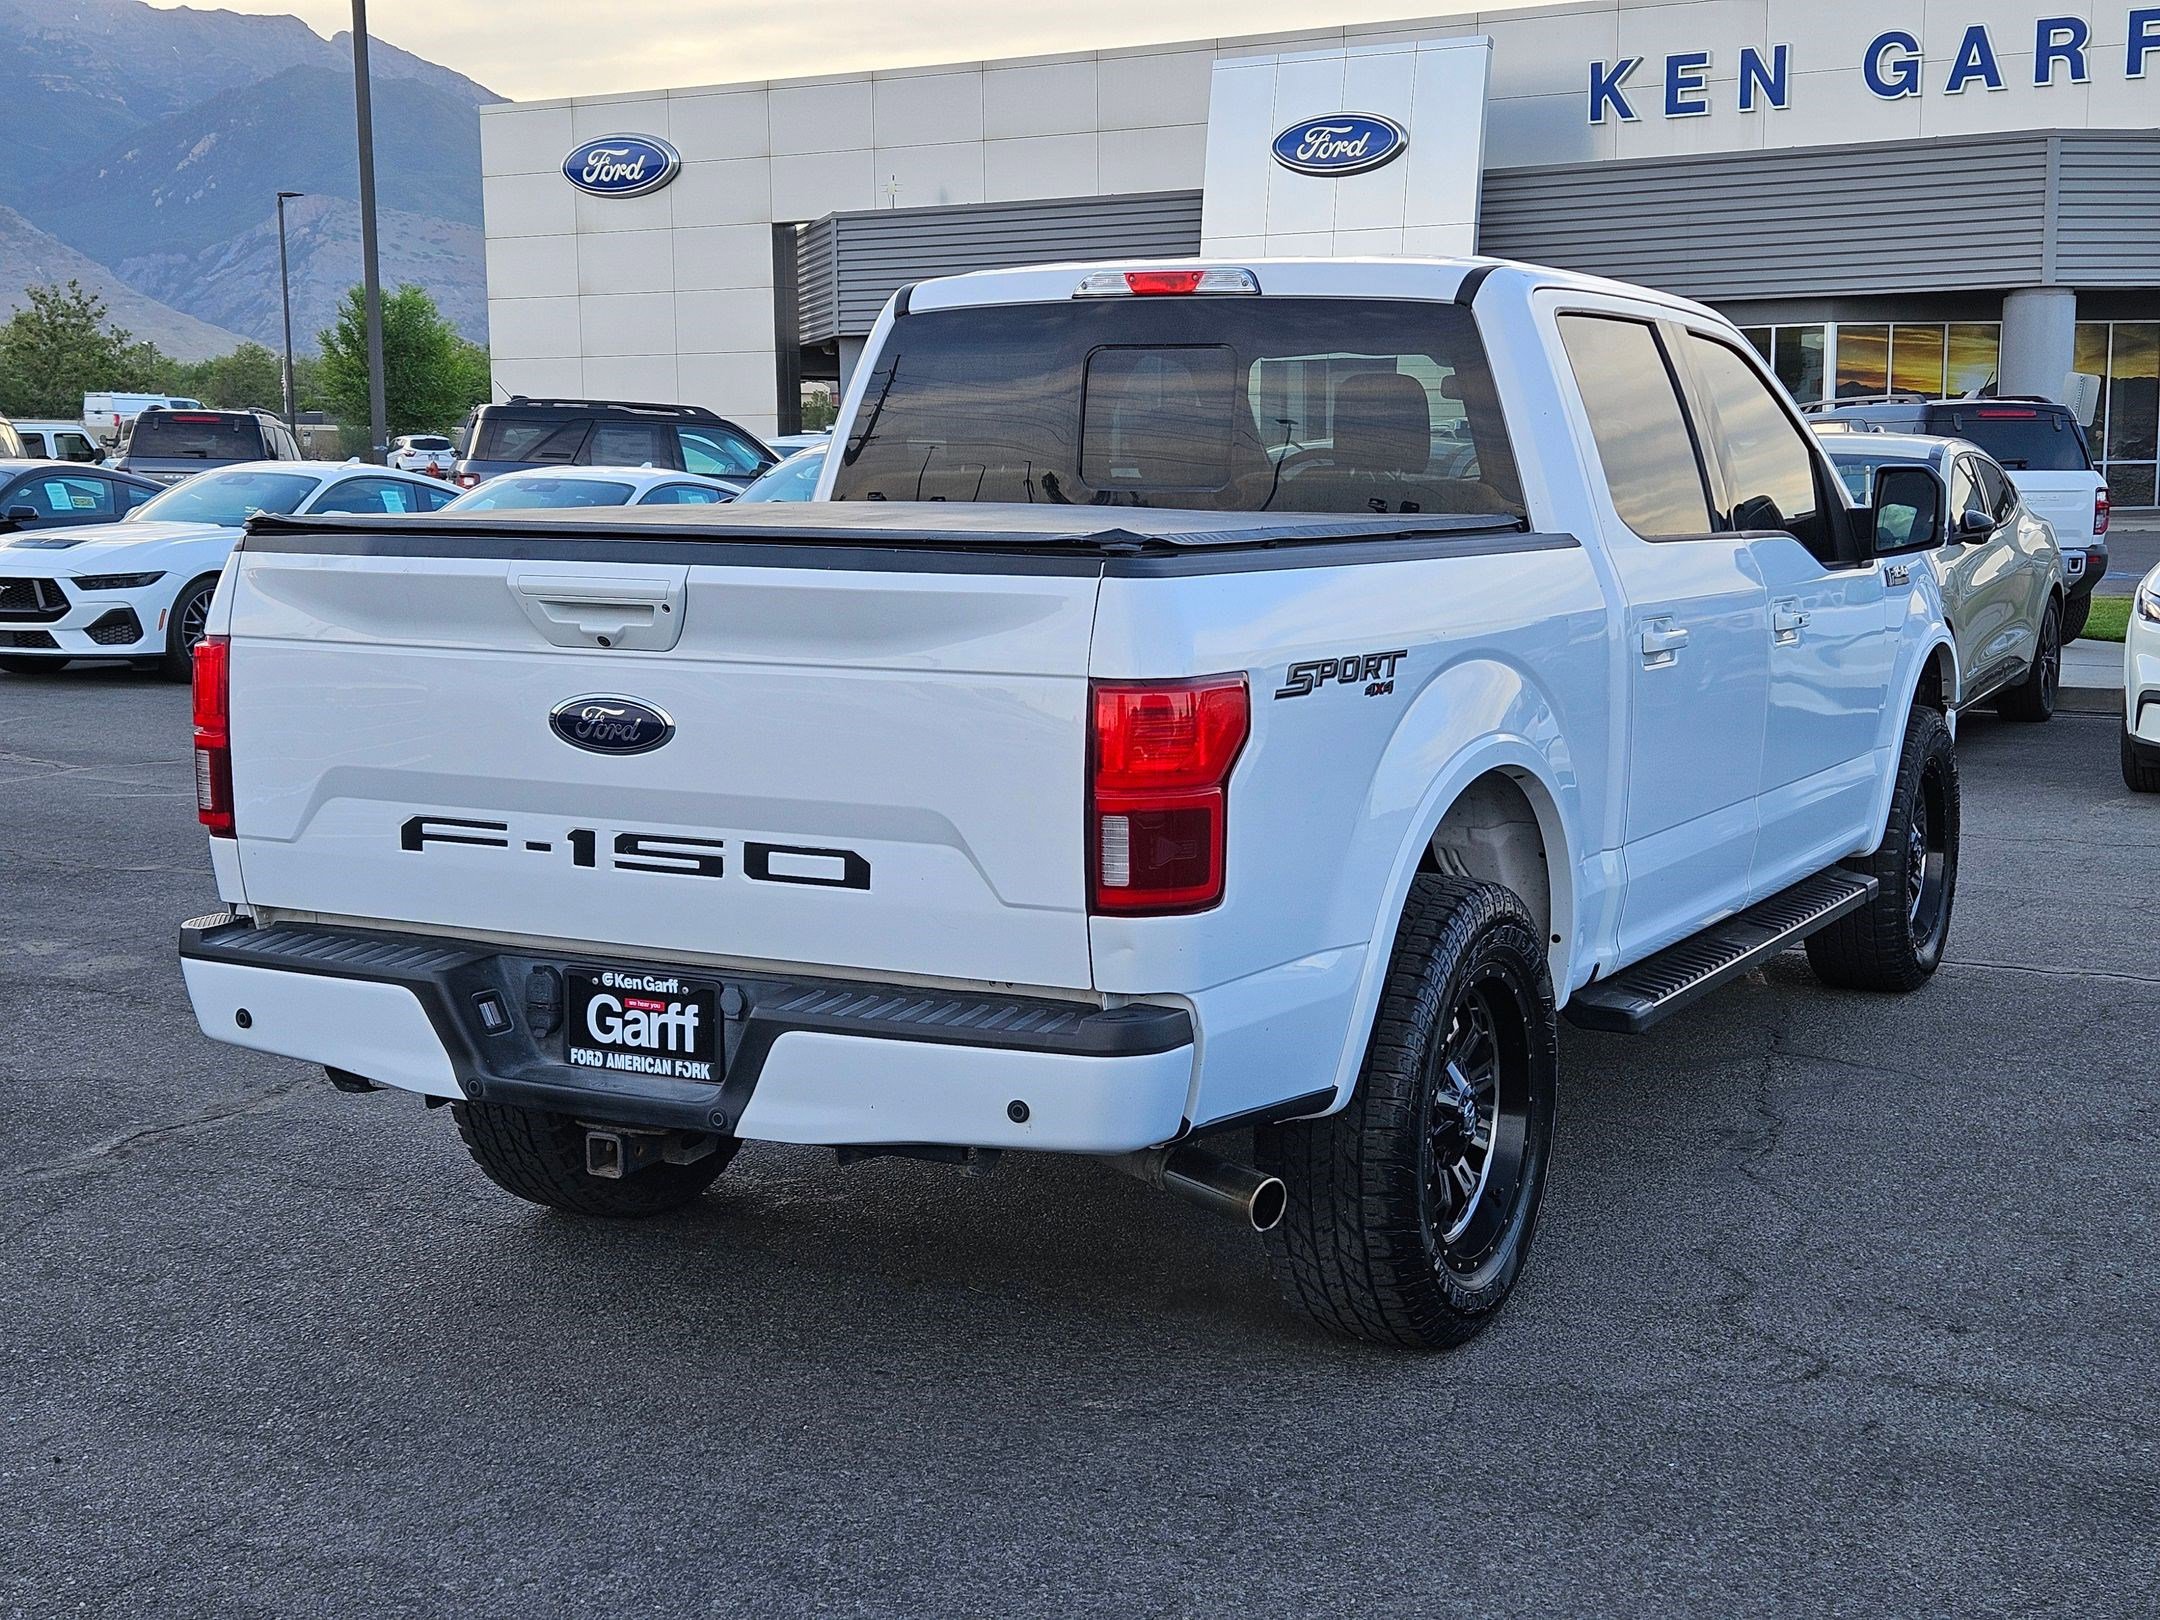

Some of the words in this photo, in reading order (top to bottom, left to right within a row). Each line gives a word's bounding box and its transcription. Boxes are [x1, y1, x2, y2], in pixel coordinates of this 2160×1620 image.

[1587, 42, 1792, 126] KEN
[1296, 126, 1371, 160] Ford
[582, 148, 645, 183] Ford
[1274, 649, 1408, 700] SPORT
[575, 705, 642, 743] Ford
[400, 814, 872, 892] F-150
[586, 993, 699, 1053] Garff
[570, 1048, 603, 1066] FORD
[606, 1053, 671, 1075] AMERICAN
[675, 1060, 711, 1080] FORK
